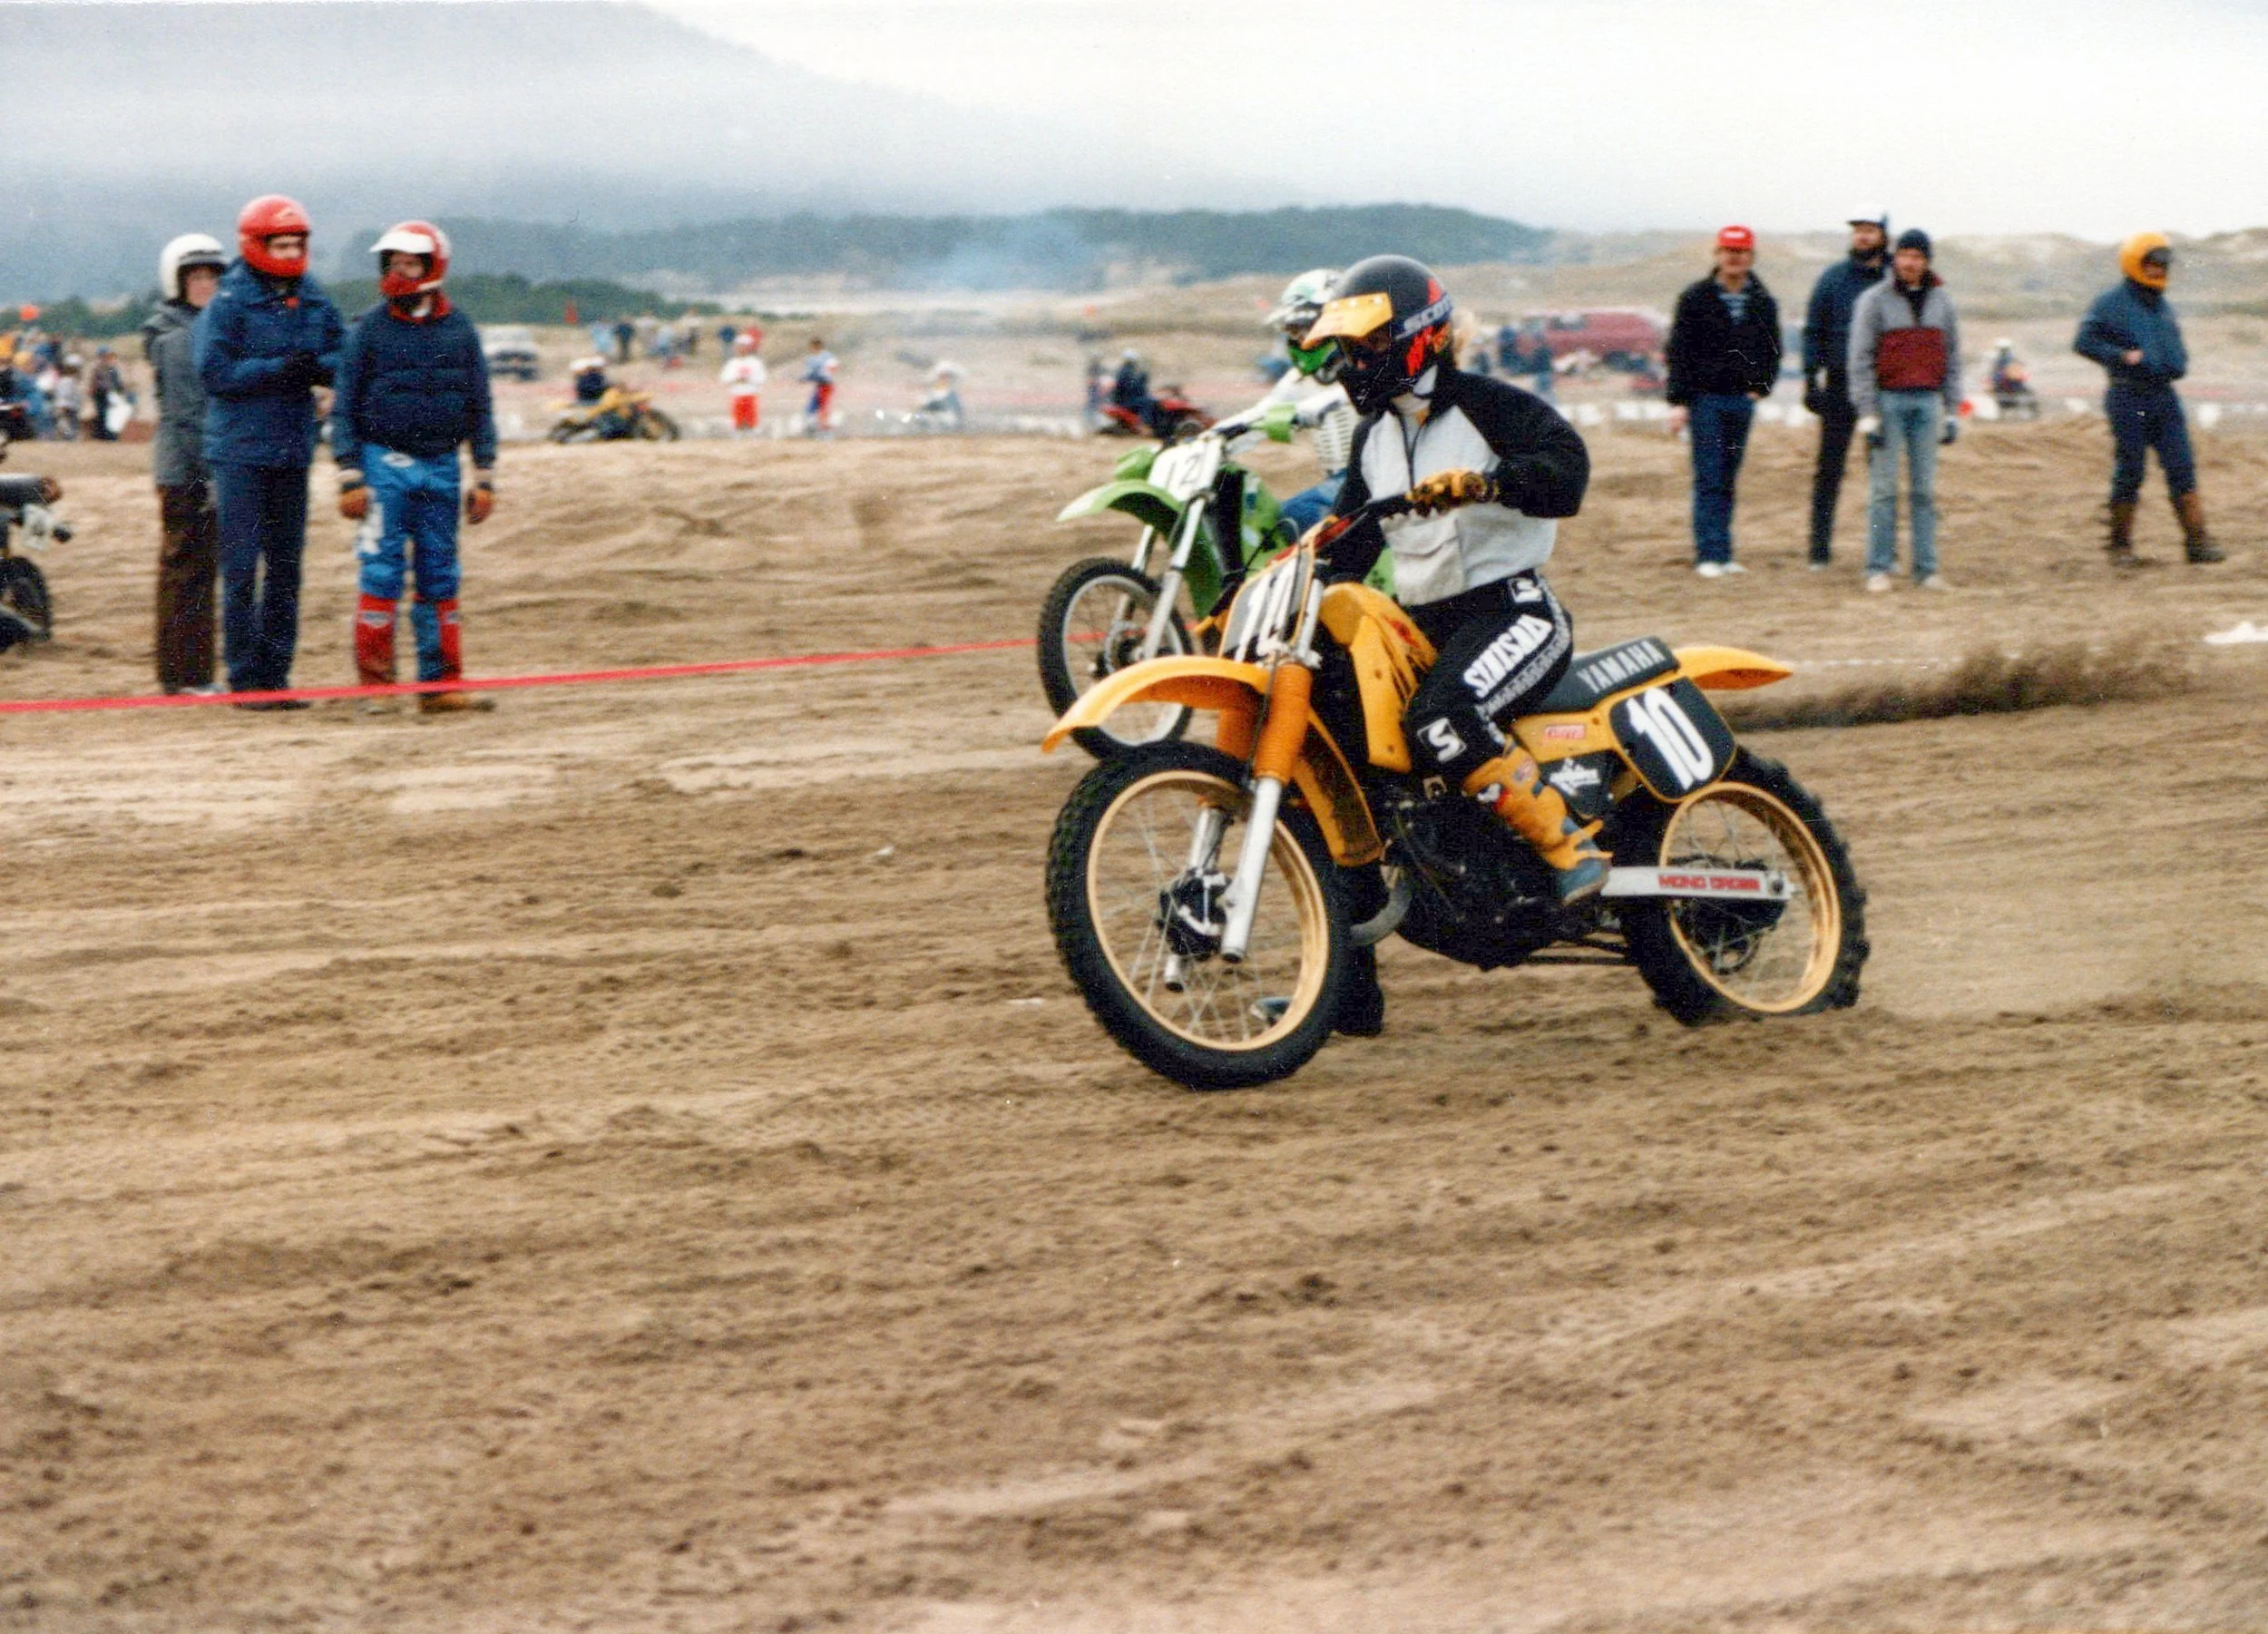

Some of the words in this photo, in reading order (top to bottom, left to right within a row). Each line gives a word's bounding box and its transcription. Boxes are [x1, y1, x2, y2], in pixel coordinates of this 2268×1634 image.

[1577, 641, 1666, 693] YAMAHA
[1428, 718, 1461, 762] S
[1626, 687, 1714, 790] 10
